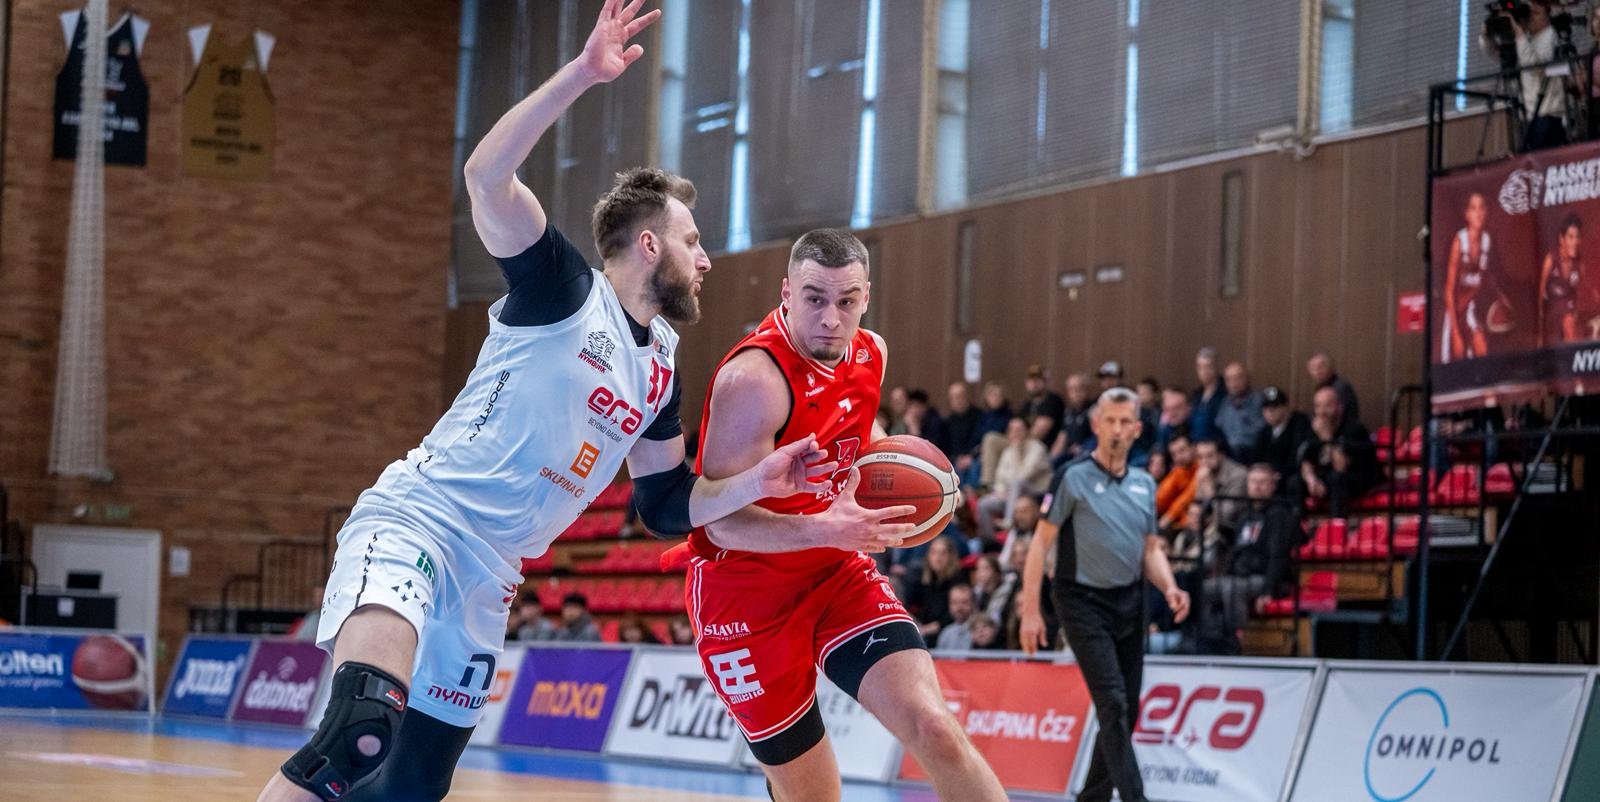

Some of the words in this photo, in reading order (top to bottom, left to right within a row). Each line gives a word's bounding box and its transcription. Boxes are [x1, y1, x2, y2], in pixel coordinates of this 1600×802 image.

[577, 352, 607, 374] NYMBURK
[587, 386, 643, 435] era
[588, 417, 609, 434] BEYOND
[605, 427, 623, 443] RADAR
[540, 466, 577, 495] SKUPINA
[703, 621, 752, 636] SLAVIA
[966, 709, 1037, 738] SKUPINA
[1038, 708, 1077, 742] ČEZ
[1132, 684, 1265, 751] era
[1376, 734, 1501, 764] OMNIPOL
